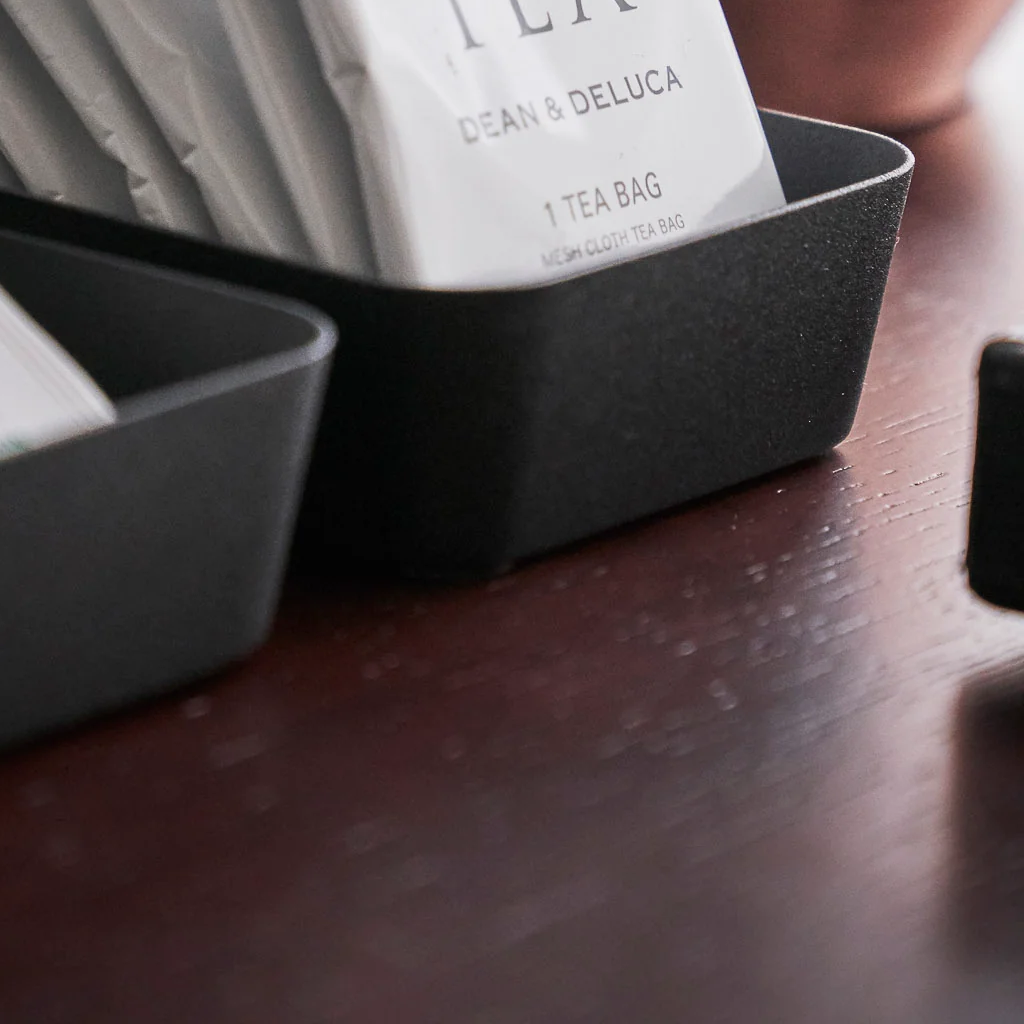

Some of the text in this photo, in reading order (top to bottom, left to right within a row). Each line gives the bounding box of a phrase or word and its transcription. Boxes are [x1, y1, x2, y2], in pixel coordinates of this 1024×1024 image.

[458, 65, 684, 145] DEAN & DELUCA
[543, 171, 664, 228] 1 TEA BAG
[540, 214, 686, 268] MESH CLOTH TEA BAG
